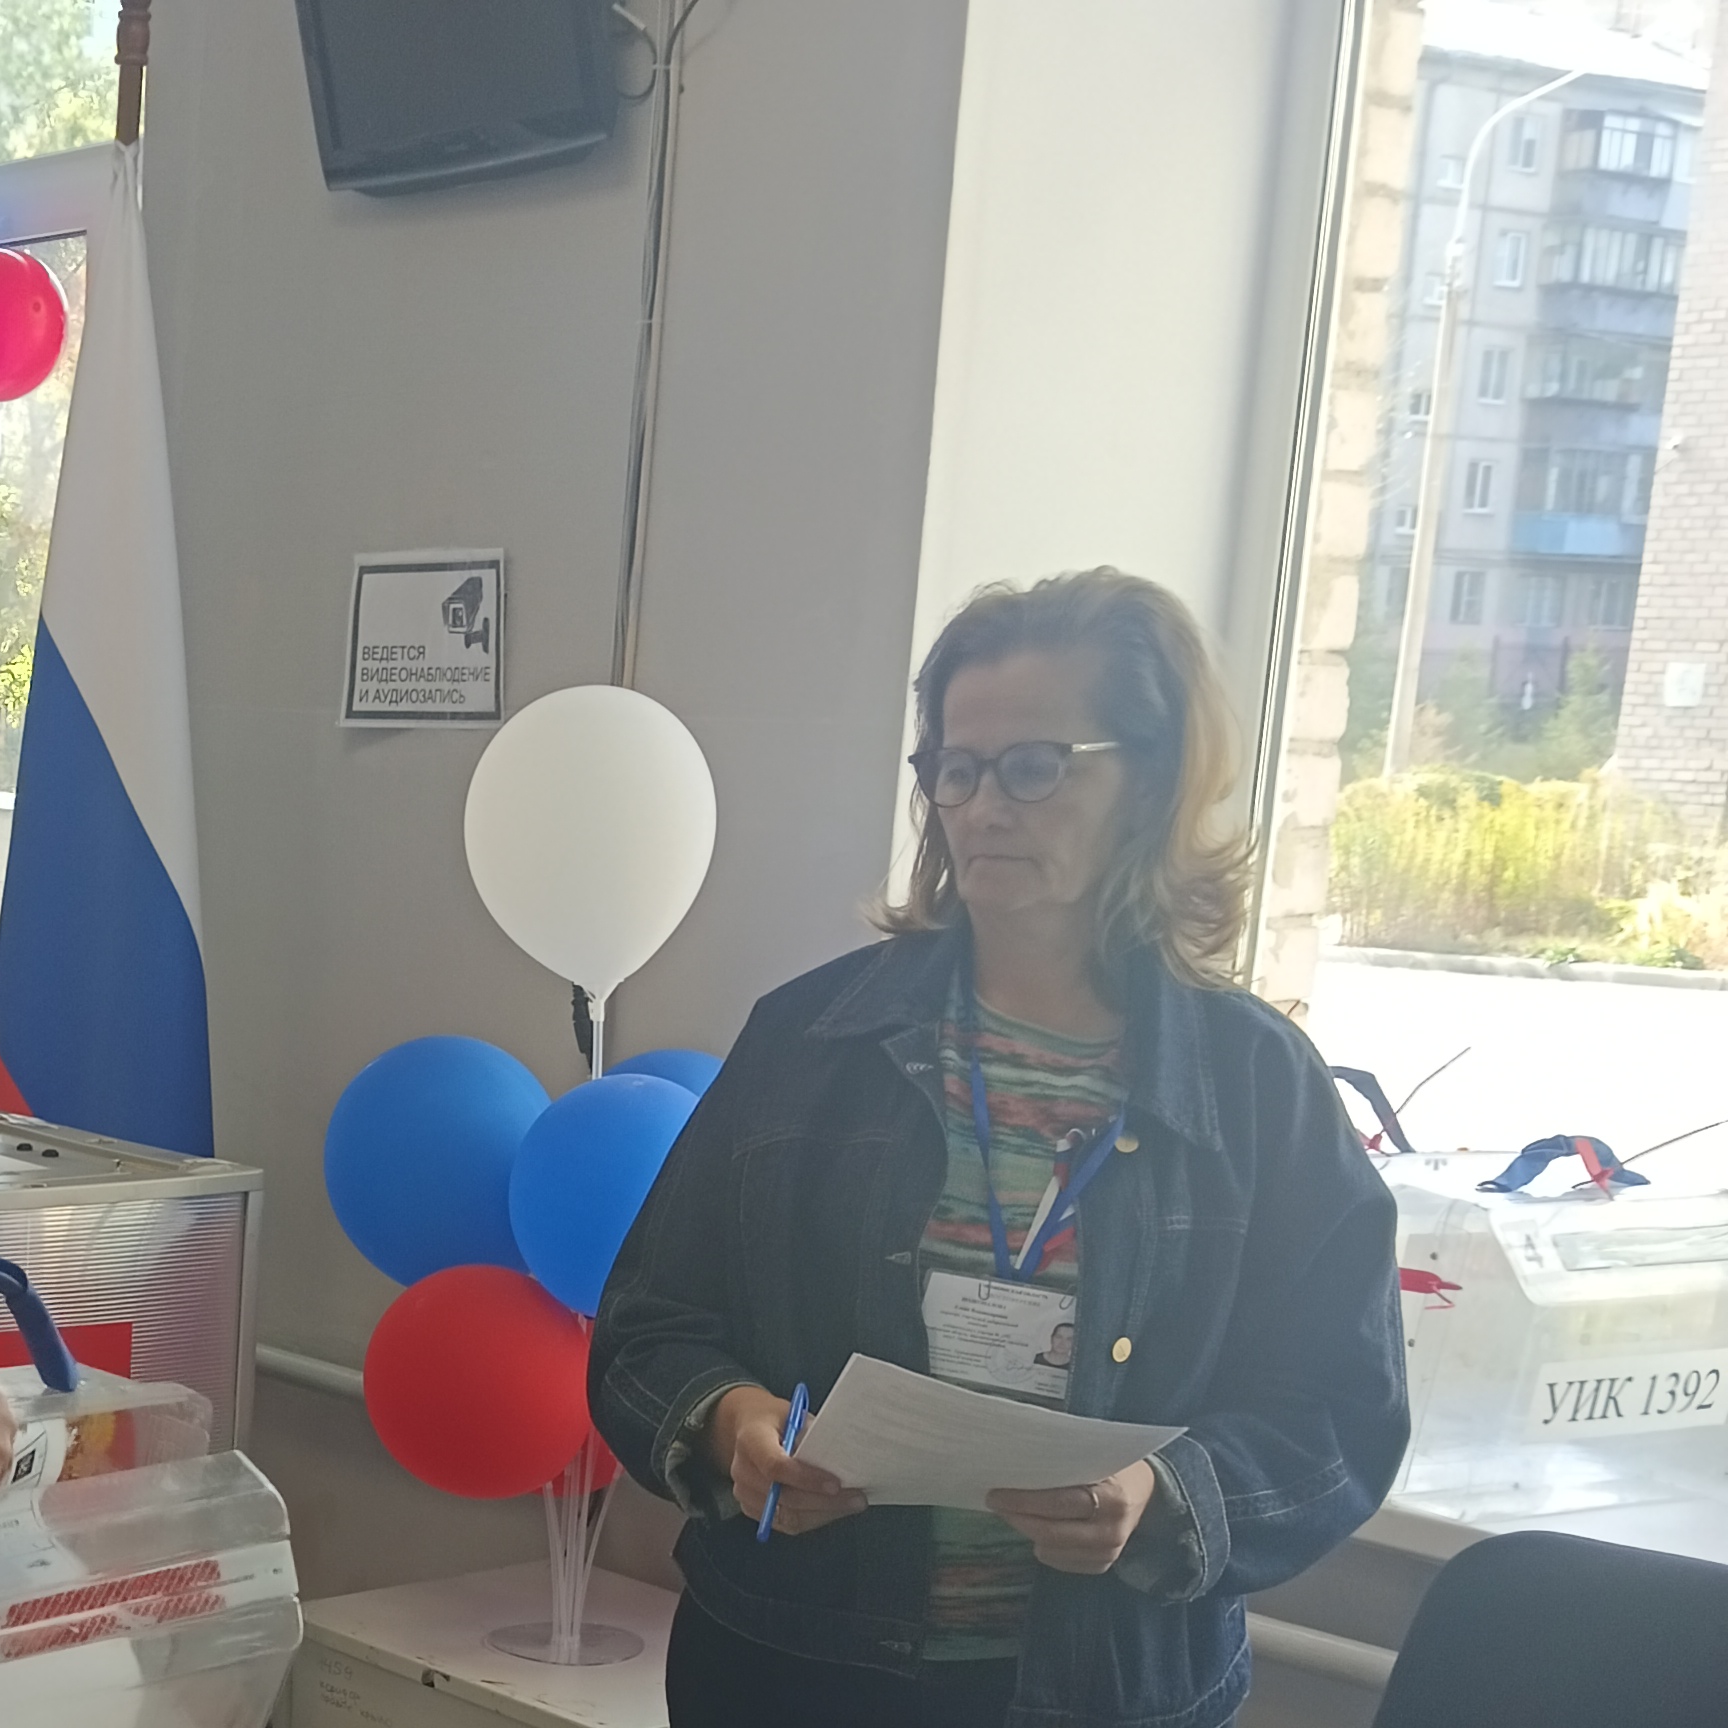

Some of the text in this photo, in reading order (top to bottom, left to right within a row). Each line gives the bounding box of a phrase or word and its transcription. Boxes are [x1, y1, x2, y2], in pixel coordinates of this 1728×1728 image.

[361, 645, 426, 663] ВЕДЕТСЯ
[360, 666, 491, 684] ВИДЕОНАБЛЮДЕНИЕ
[359, 688, 466, 706] И АУДИОЗАПИСЬ
[1542, 1369, 1720, 1425] УИК 1392
